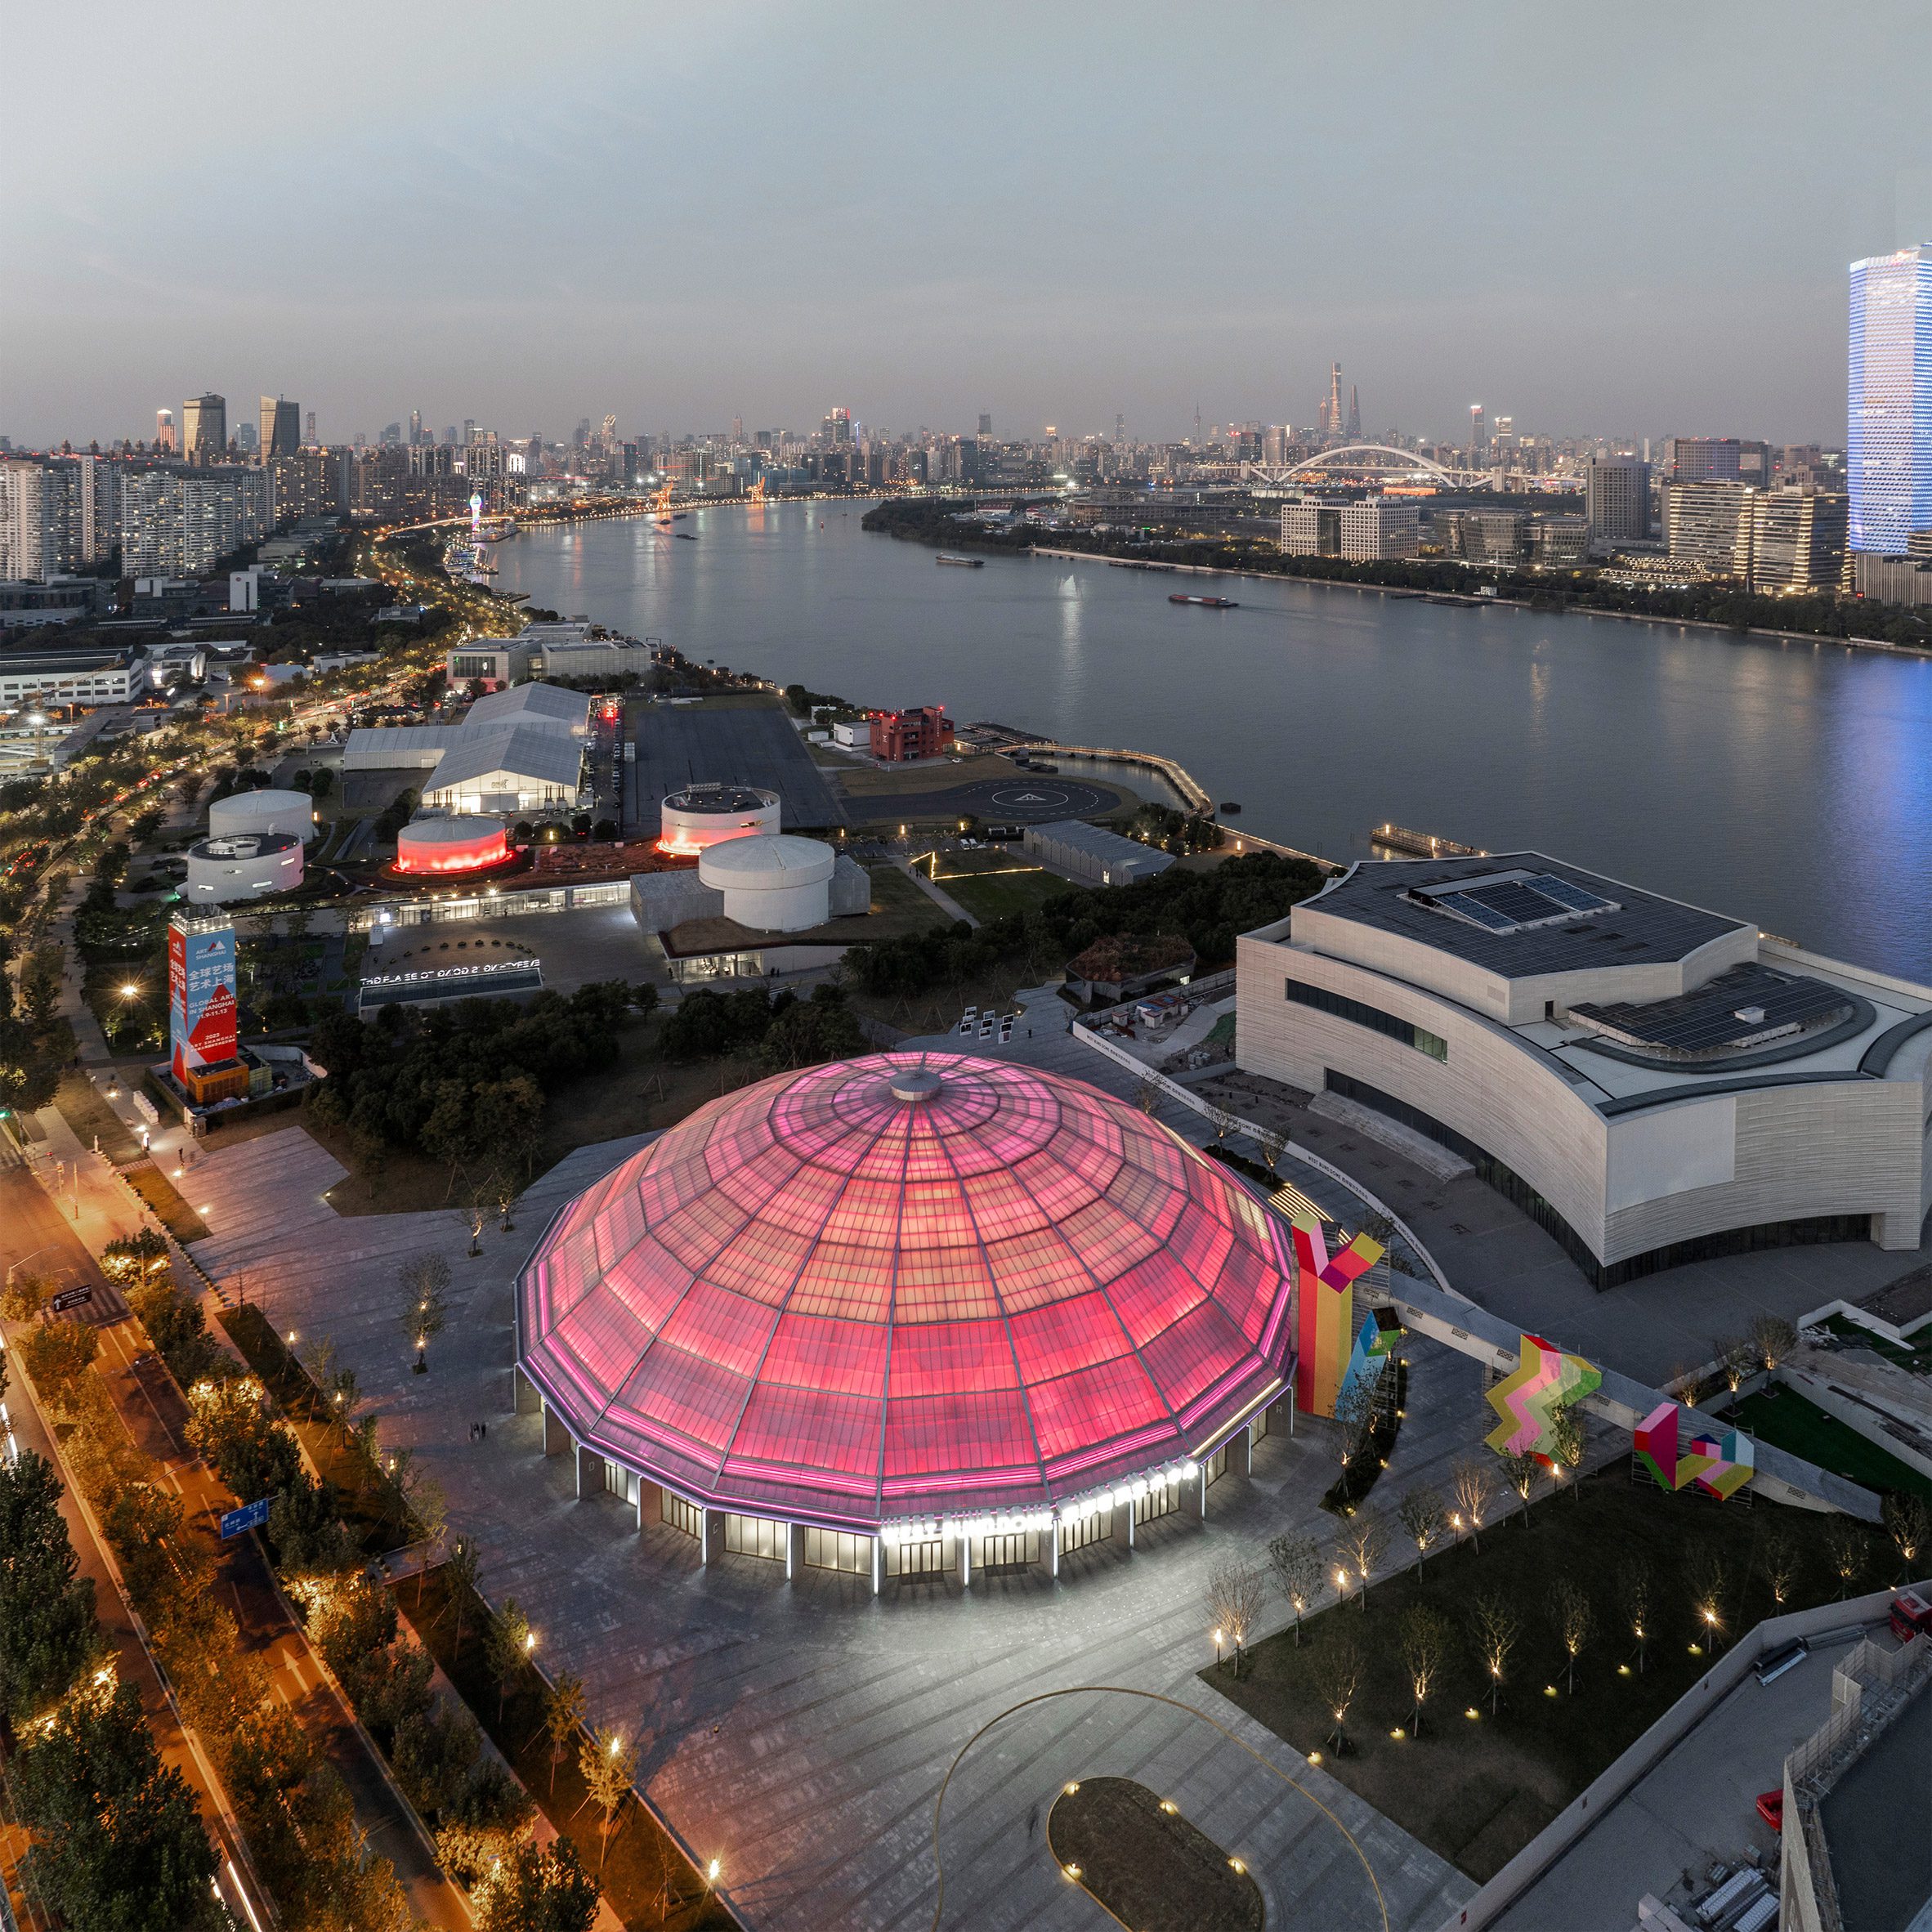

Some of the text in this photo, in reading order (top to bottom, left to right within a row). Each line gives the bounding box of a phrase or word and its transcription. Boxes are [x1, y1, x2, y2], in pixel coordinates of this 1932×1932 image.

[196, 950, 227, 960] SHANGHAI
[189, 962, 235, 981] 全球艺场
[189, 974, 235, 992] 艺术上海
[189, 993, 234, 1008] GLOBAL ART
[198, 1000, 235, 1013] SHANGHAI
[205, 1032, 220, 1040] 2023
[525, 1381, 530, 1390] E
[1276, 1405, 1282, 1414] R
[995, 1512, 1054, 1534] DOME
